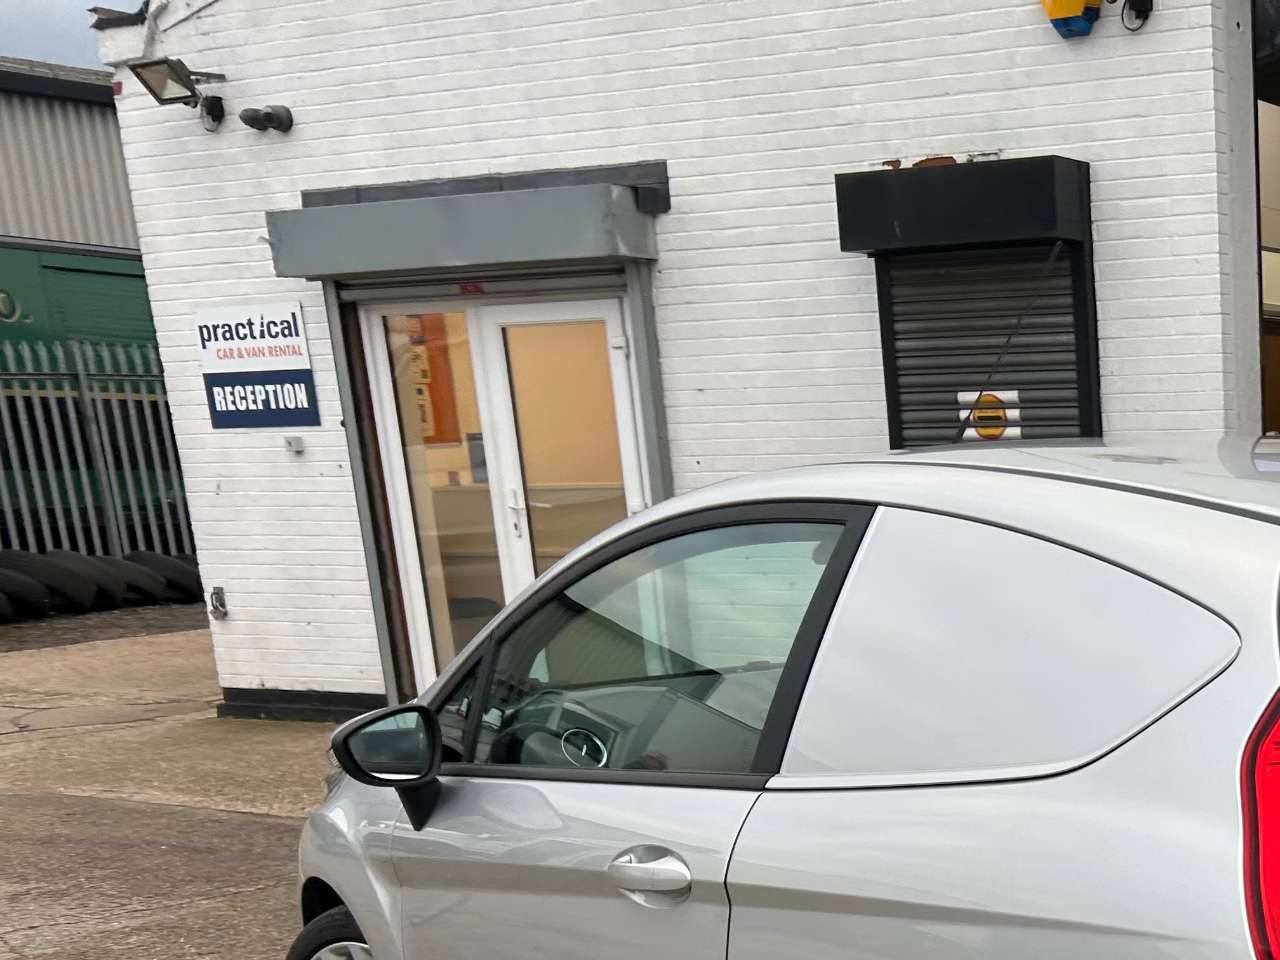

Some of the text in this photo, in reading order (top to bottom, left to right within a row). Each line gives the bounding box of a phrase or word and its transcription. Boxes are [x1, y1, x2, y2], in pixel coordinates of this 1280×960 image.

[198, 311, 300, 349] practical
[216, 348, 235, 360] CAR
[244, 345, 266, 358] VAN
[267, 343, 303, 357] RENTAL
[212, 383, 309, 411] RECEPTION
